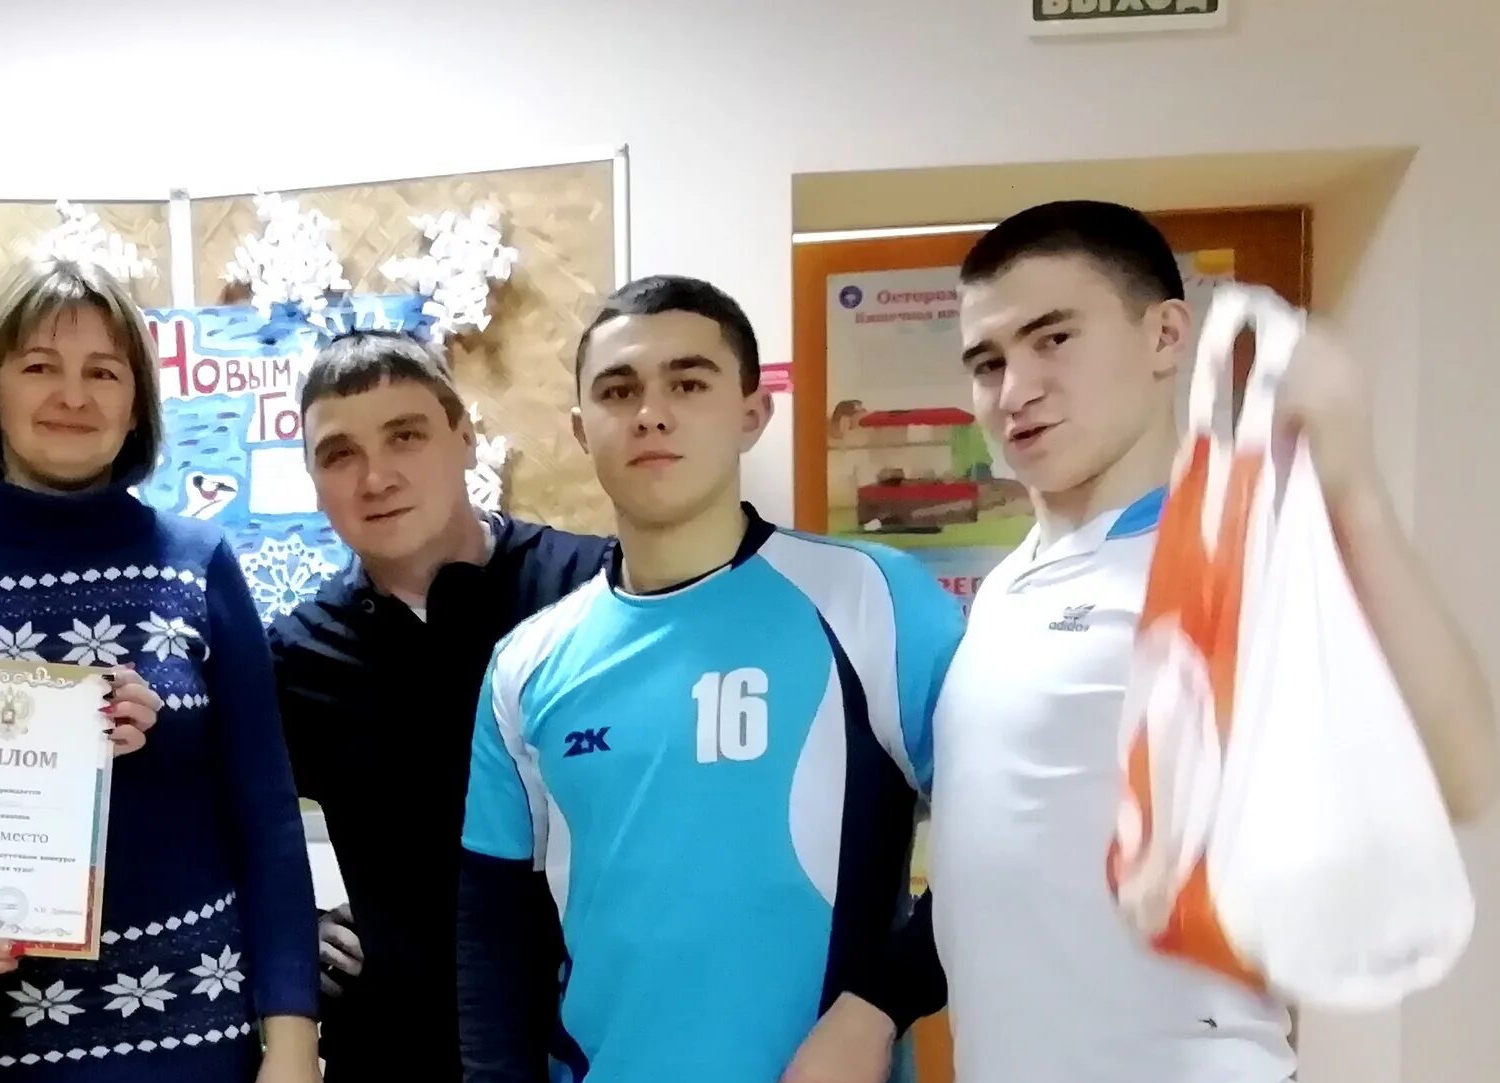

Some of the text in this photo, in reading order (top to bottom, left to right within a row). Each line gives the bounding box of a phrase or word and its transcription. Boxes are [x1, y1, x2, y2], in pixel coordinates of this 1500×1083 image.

[260, 391, 302, 440] Го
[692, 667, 768, 764] 16
[563, 726, 612, 758] 2K
[0, 831, 49, 844] место
